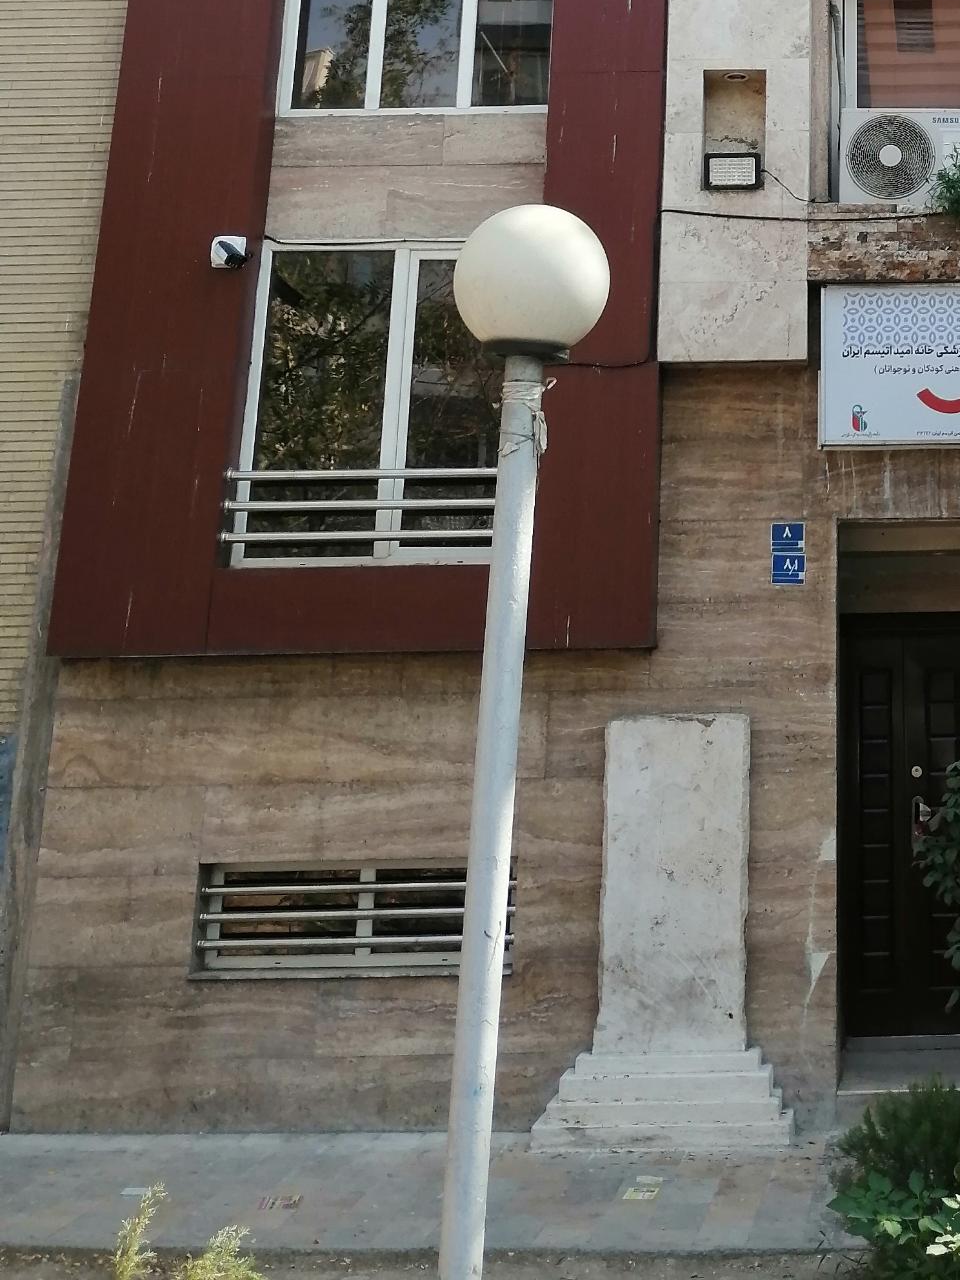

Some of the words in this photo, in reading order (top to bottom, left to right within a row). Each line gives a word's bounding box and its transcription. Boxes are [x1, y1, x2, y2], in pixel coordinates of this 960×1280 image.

[842, 345, 862, 358] ایران
[863, 345, 892, 359] اتیسم
[893, 345, 914, 358] امید
[915, 345, 934, 355] خانه
[917, 364, 944, 375] کودکان
